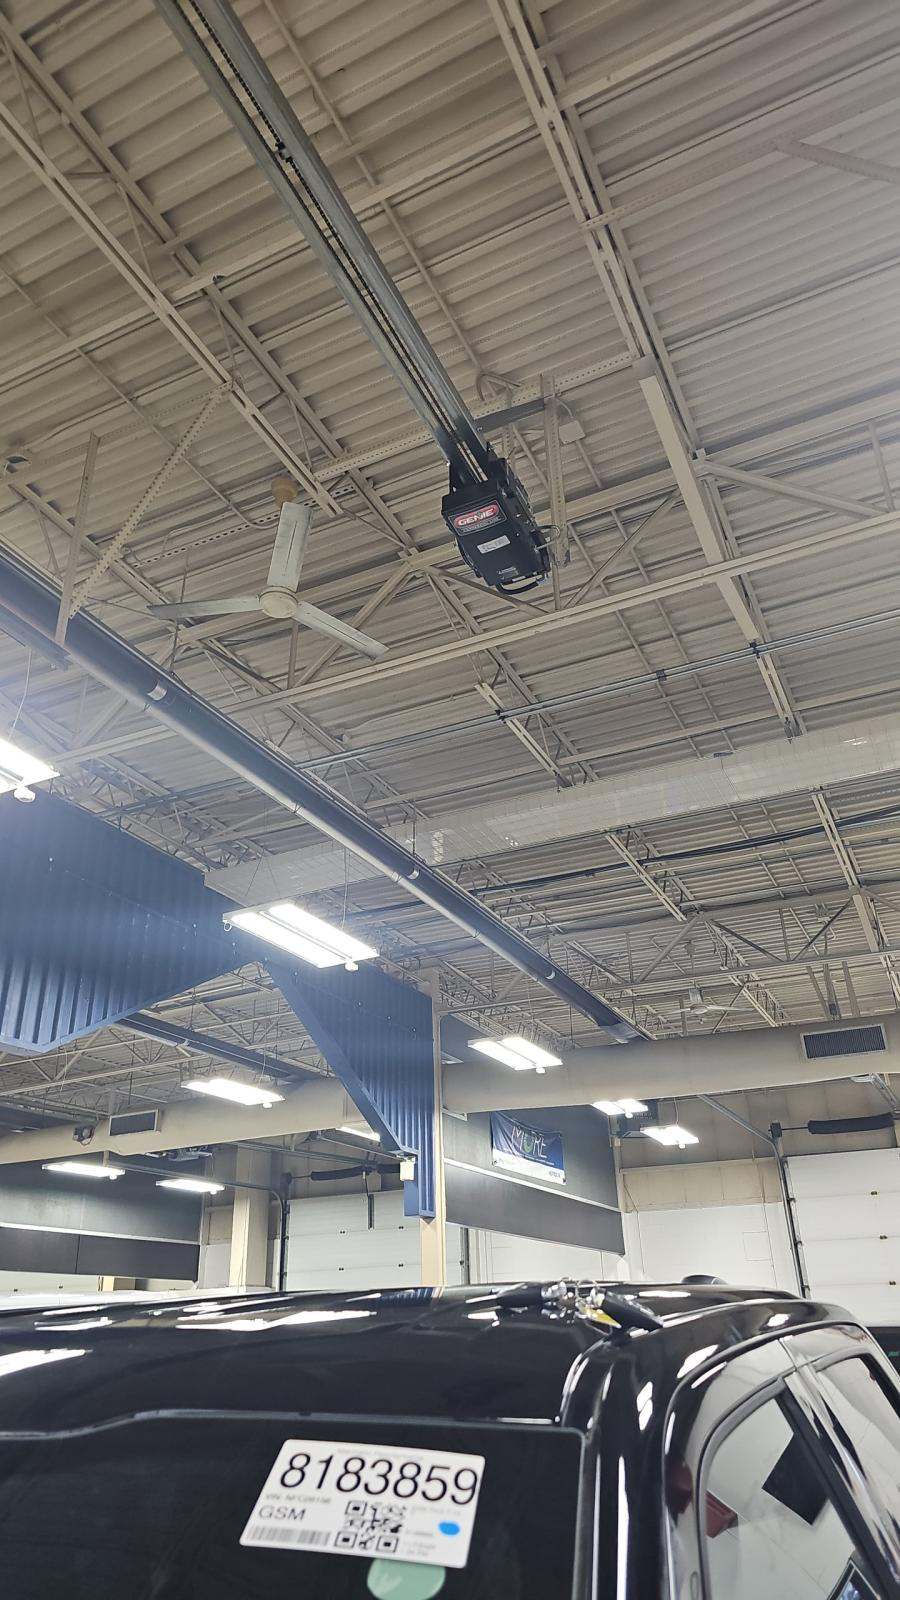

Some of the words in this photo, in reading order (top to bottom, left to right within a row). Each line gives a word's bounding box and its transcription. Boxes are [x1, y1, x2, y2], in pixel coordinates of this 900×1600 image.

[458, 508, 495, 526] GENIE
[280, 1453, 478, 1505] 8183859
[258, 1505, 306, 1521] GSM
